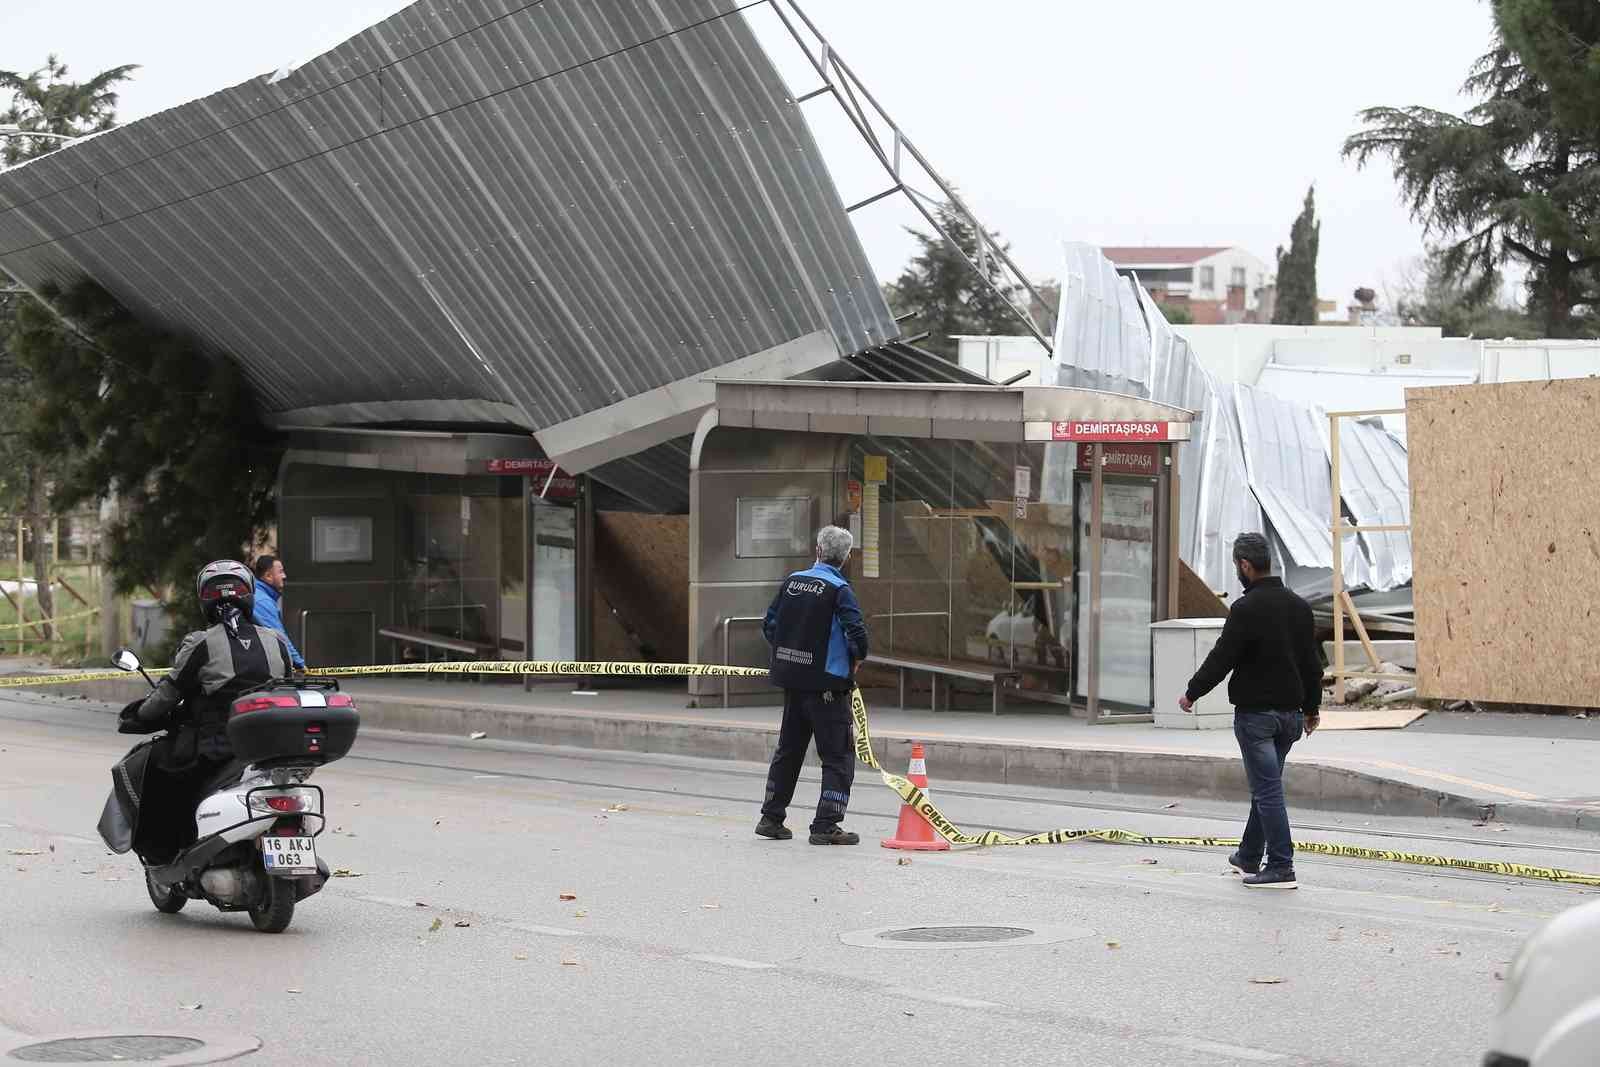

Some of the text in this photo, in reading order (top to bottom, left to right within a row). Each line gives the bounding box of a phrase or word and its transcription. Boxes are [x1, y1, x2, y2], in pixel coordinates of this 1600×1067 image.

[1075, 422, 1159, 436] DEMİRTAŞPAŞA
[1104, 450, 1152, 468] EMİRTAŞPAŞA
[267, 839, 312, 851] 16 AKJ
[279, 854, 302, 865] 063
